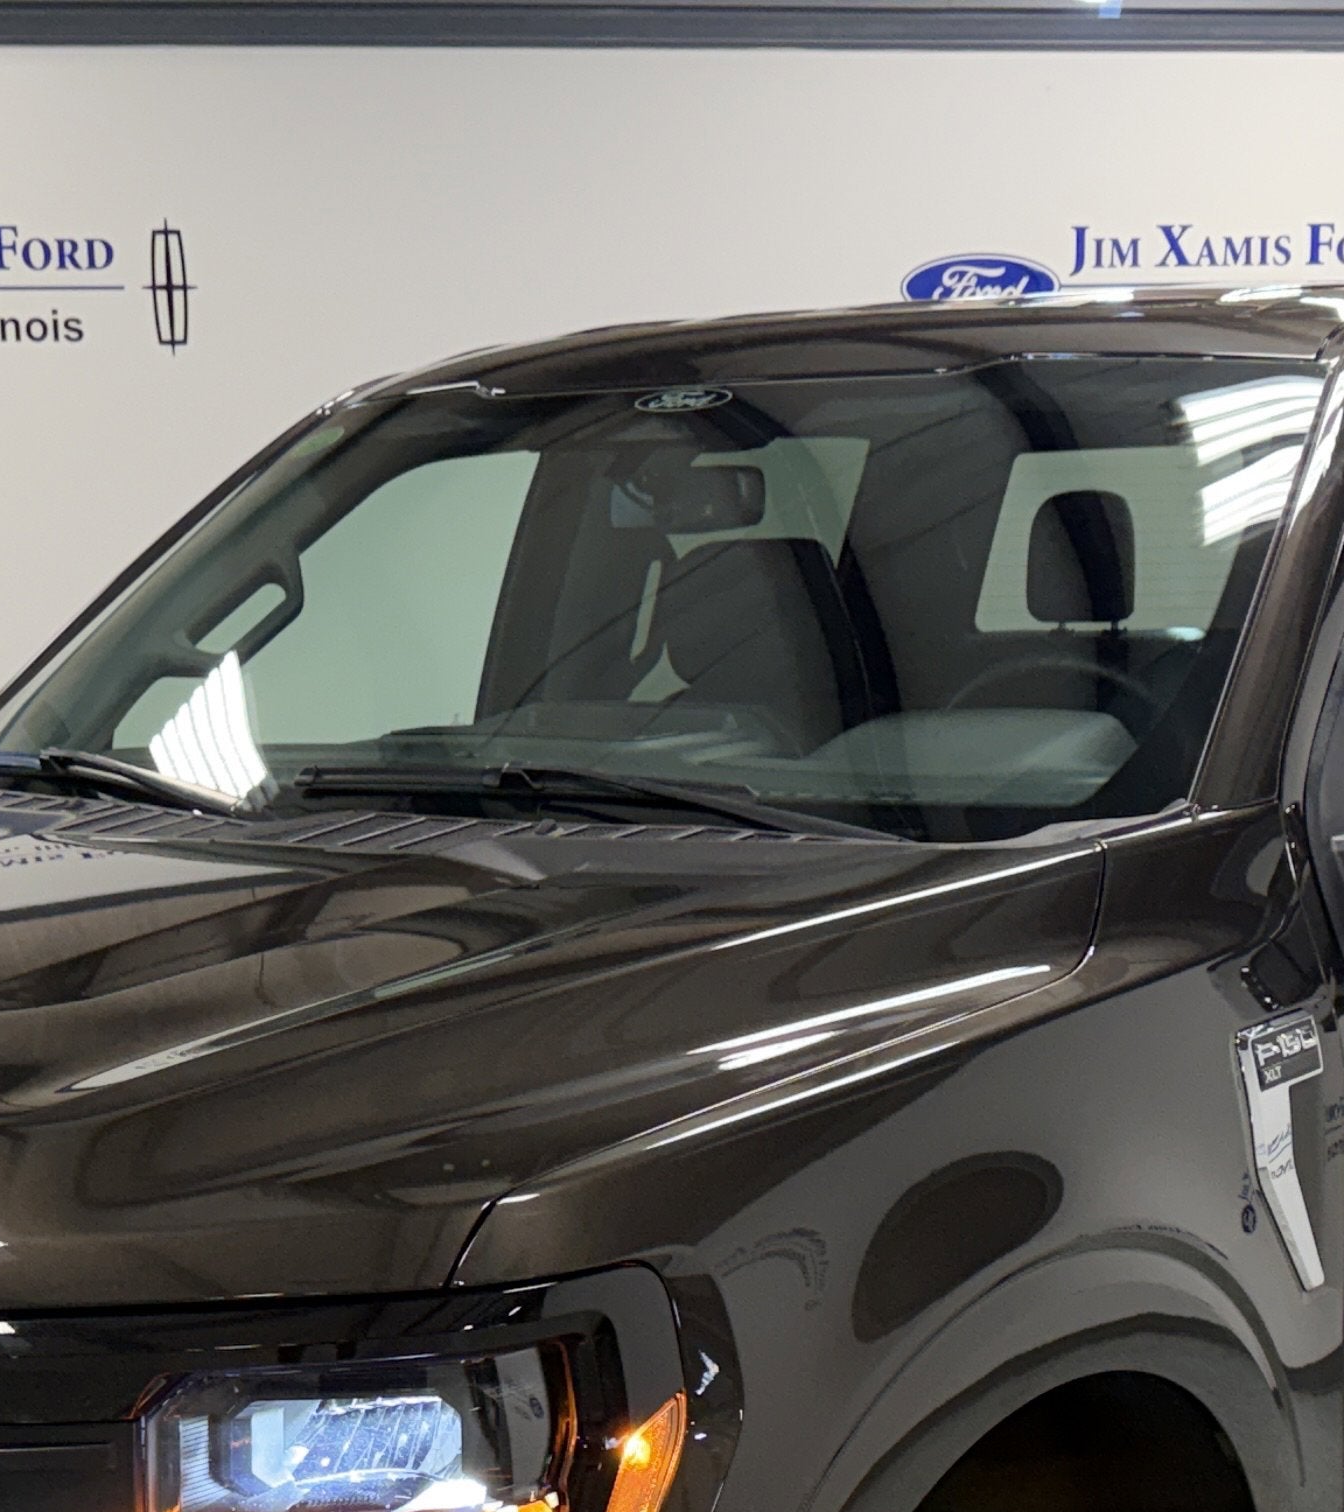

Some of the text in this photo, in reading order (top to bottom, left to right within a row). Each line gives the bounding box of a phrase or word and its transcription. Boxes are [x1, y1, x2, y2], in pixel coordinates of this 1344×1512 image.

[1068, 226, 1142, 276] JIM
[1154, 223, 1292, 268] XAMIS
[1264, 1065, 1283, 1084] XLT
